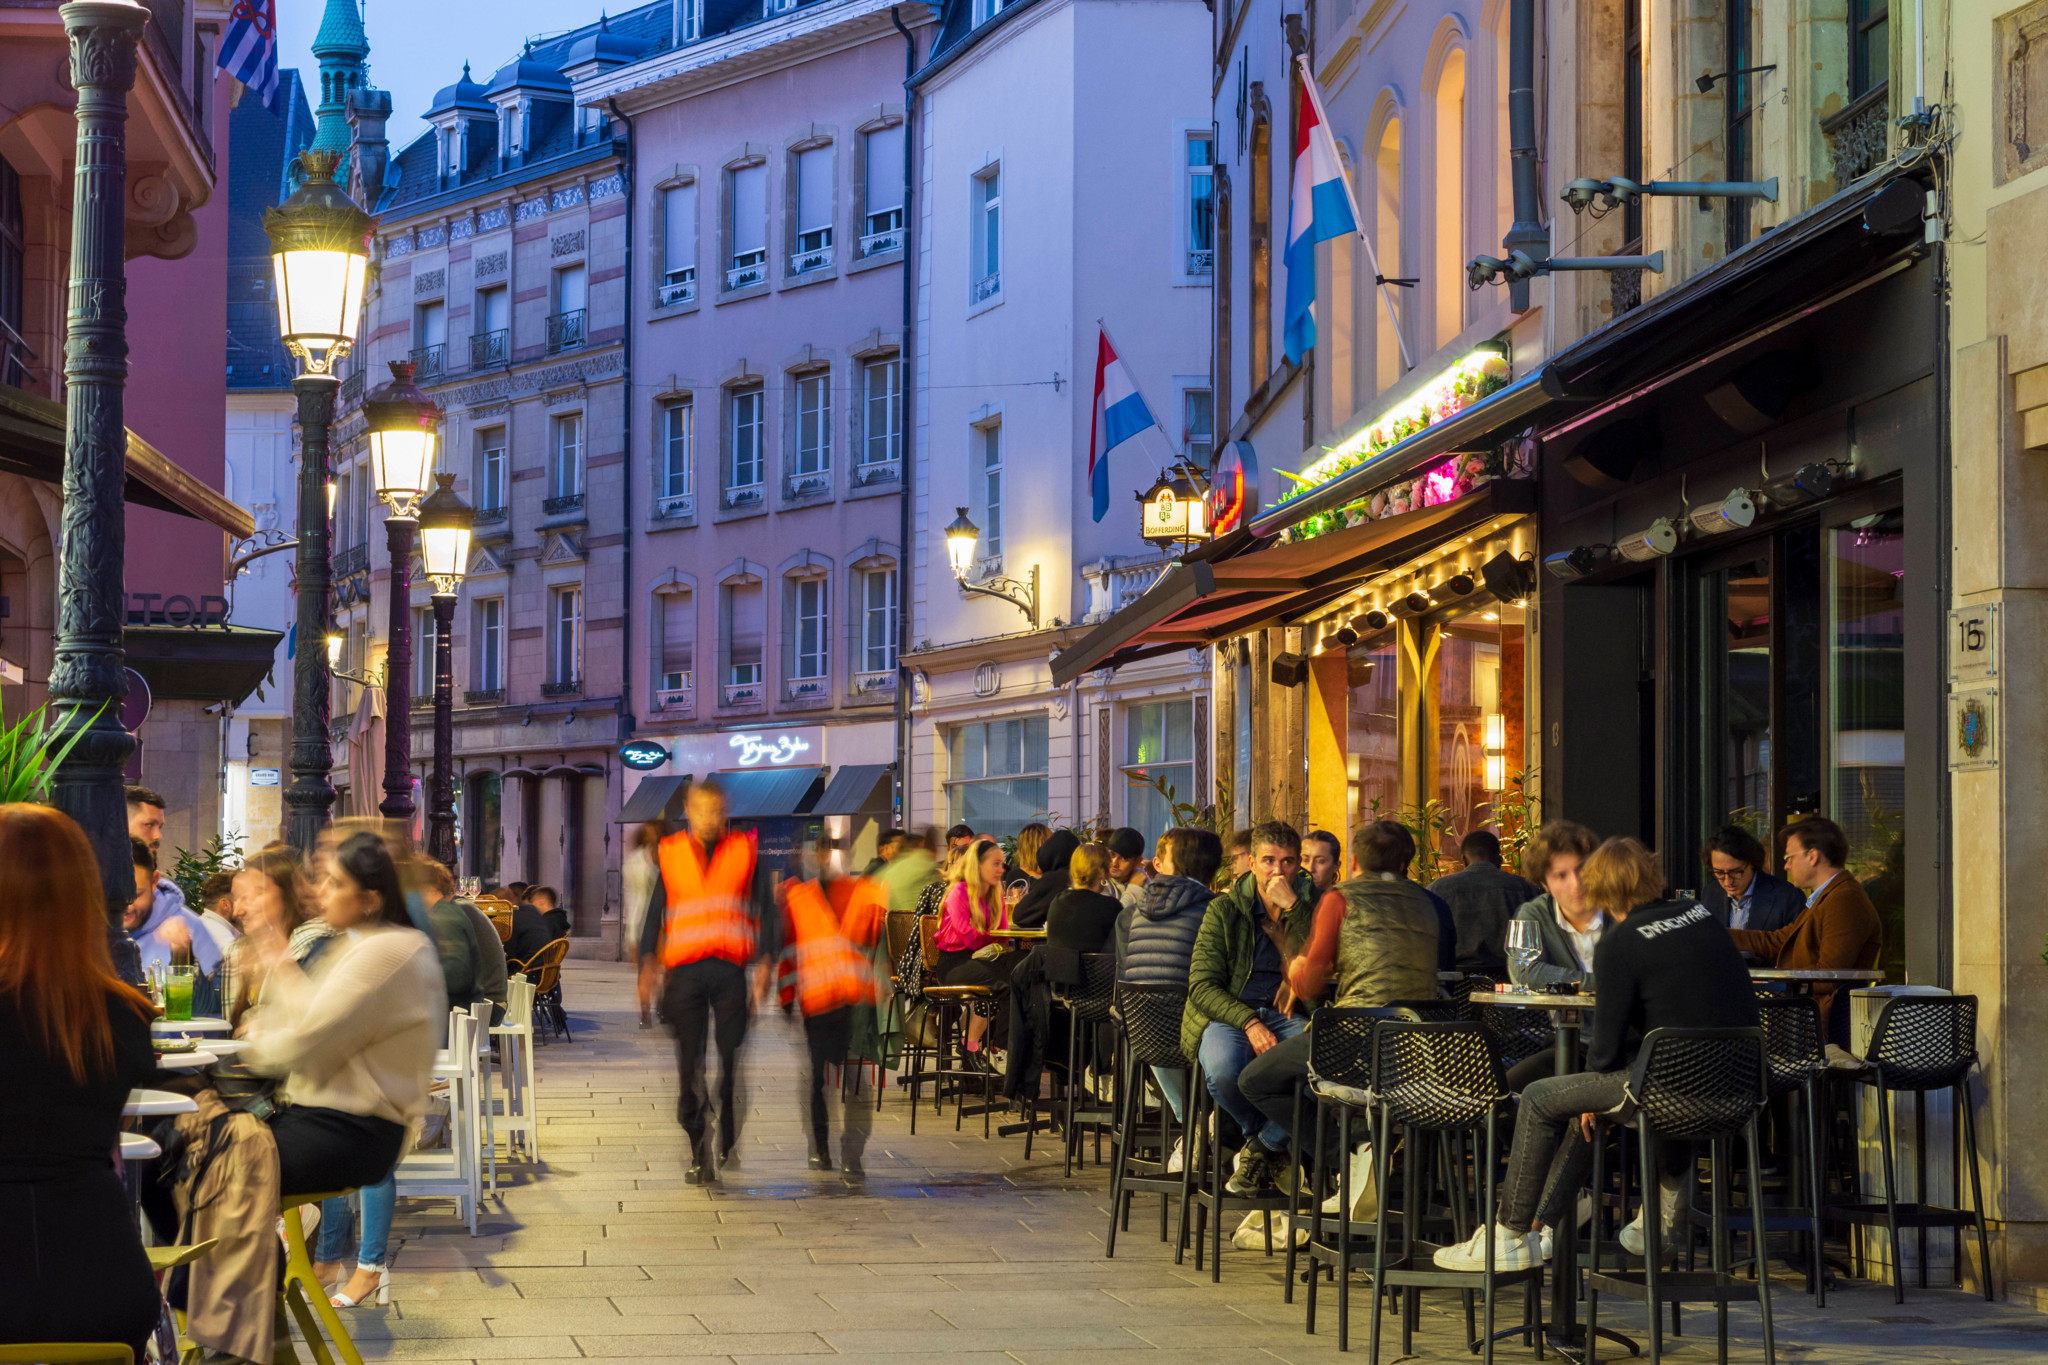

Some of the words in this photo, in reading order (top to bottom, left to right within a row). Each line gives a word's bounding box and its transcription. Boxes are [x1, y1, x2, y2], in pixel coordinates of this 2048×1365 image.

[1145, 525, 1185, 534] BOFFERDING
[1959, 619, 1981, 652] 15
[1552, 721, 1559, 747] 13
